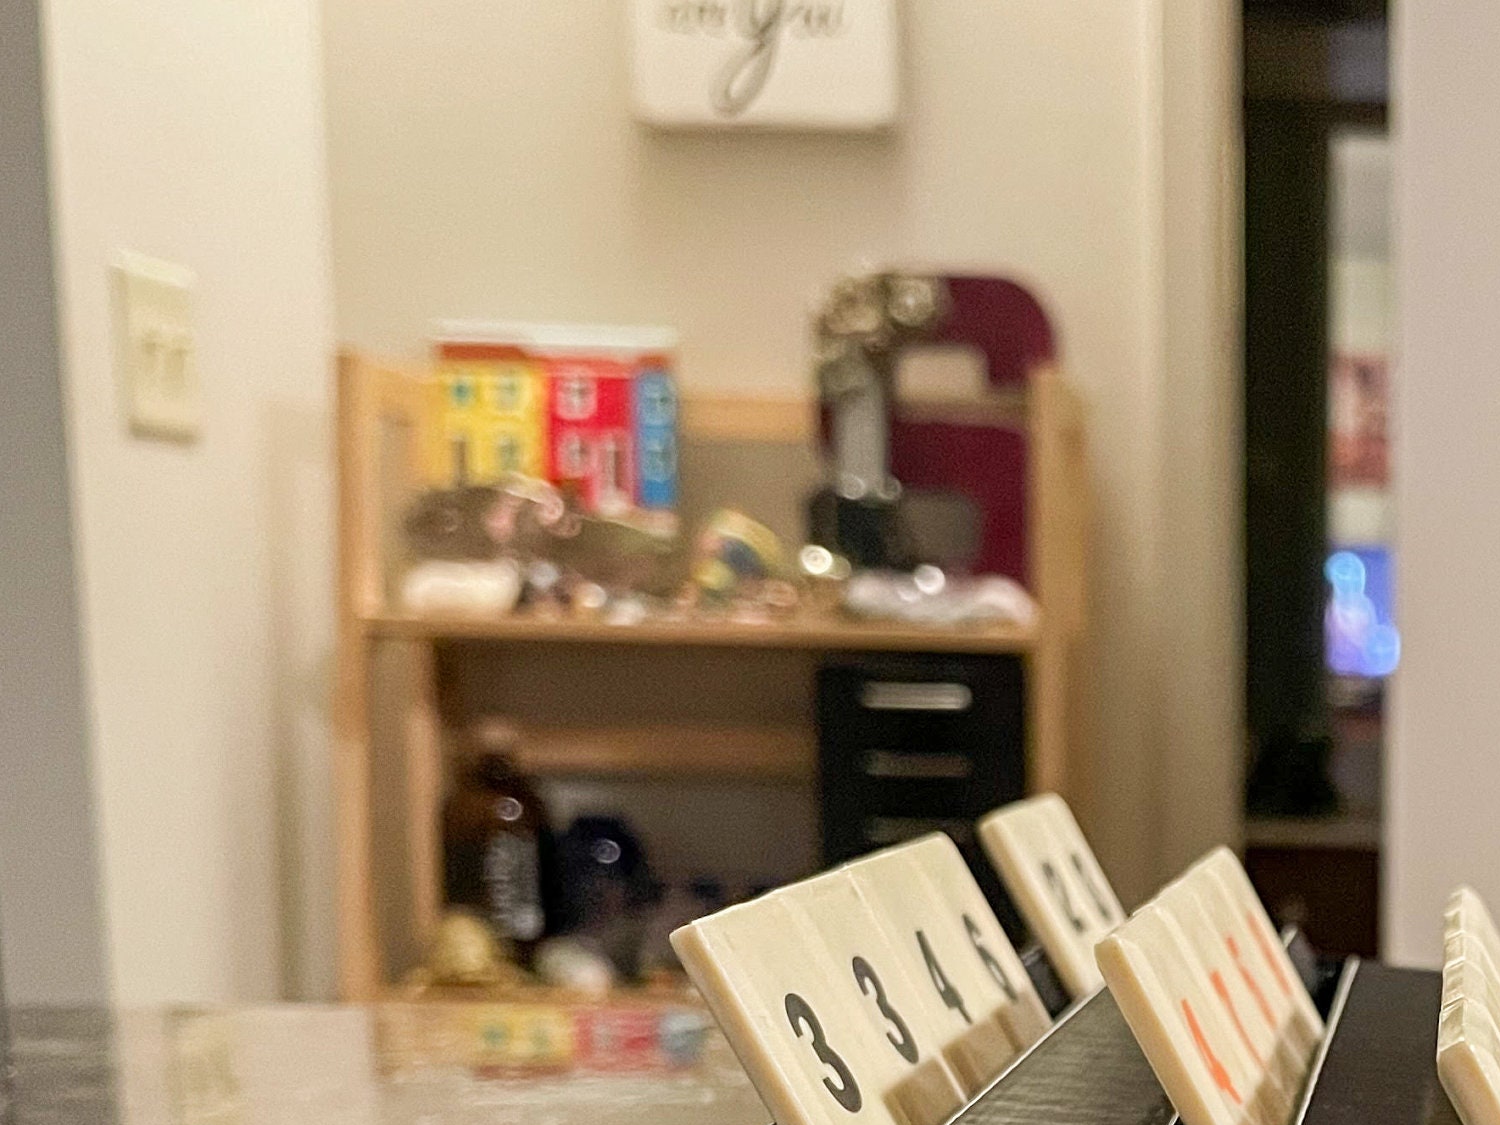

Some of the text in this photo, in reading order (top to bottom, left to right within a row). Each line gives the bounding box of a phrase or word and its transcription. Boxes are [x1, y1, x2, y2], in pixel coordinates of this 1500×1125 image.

[784, 913, 1018, 1113] 3 3 4 6
